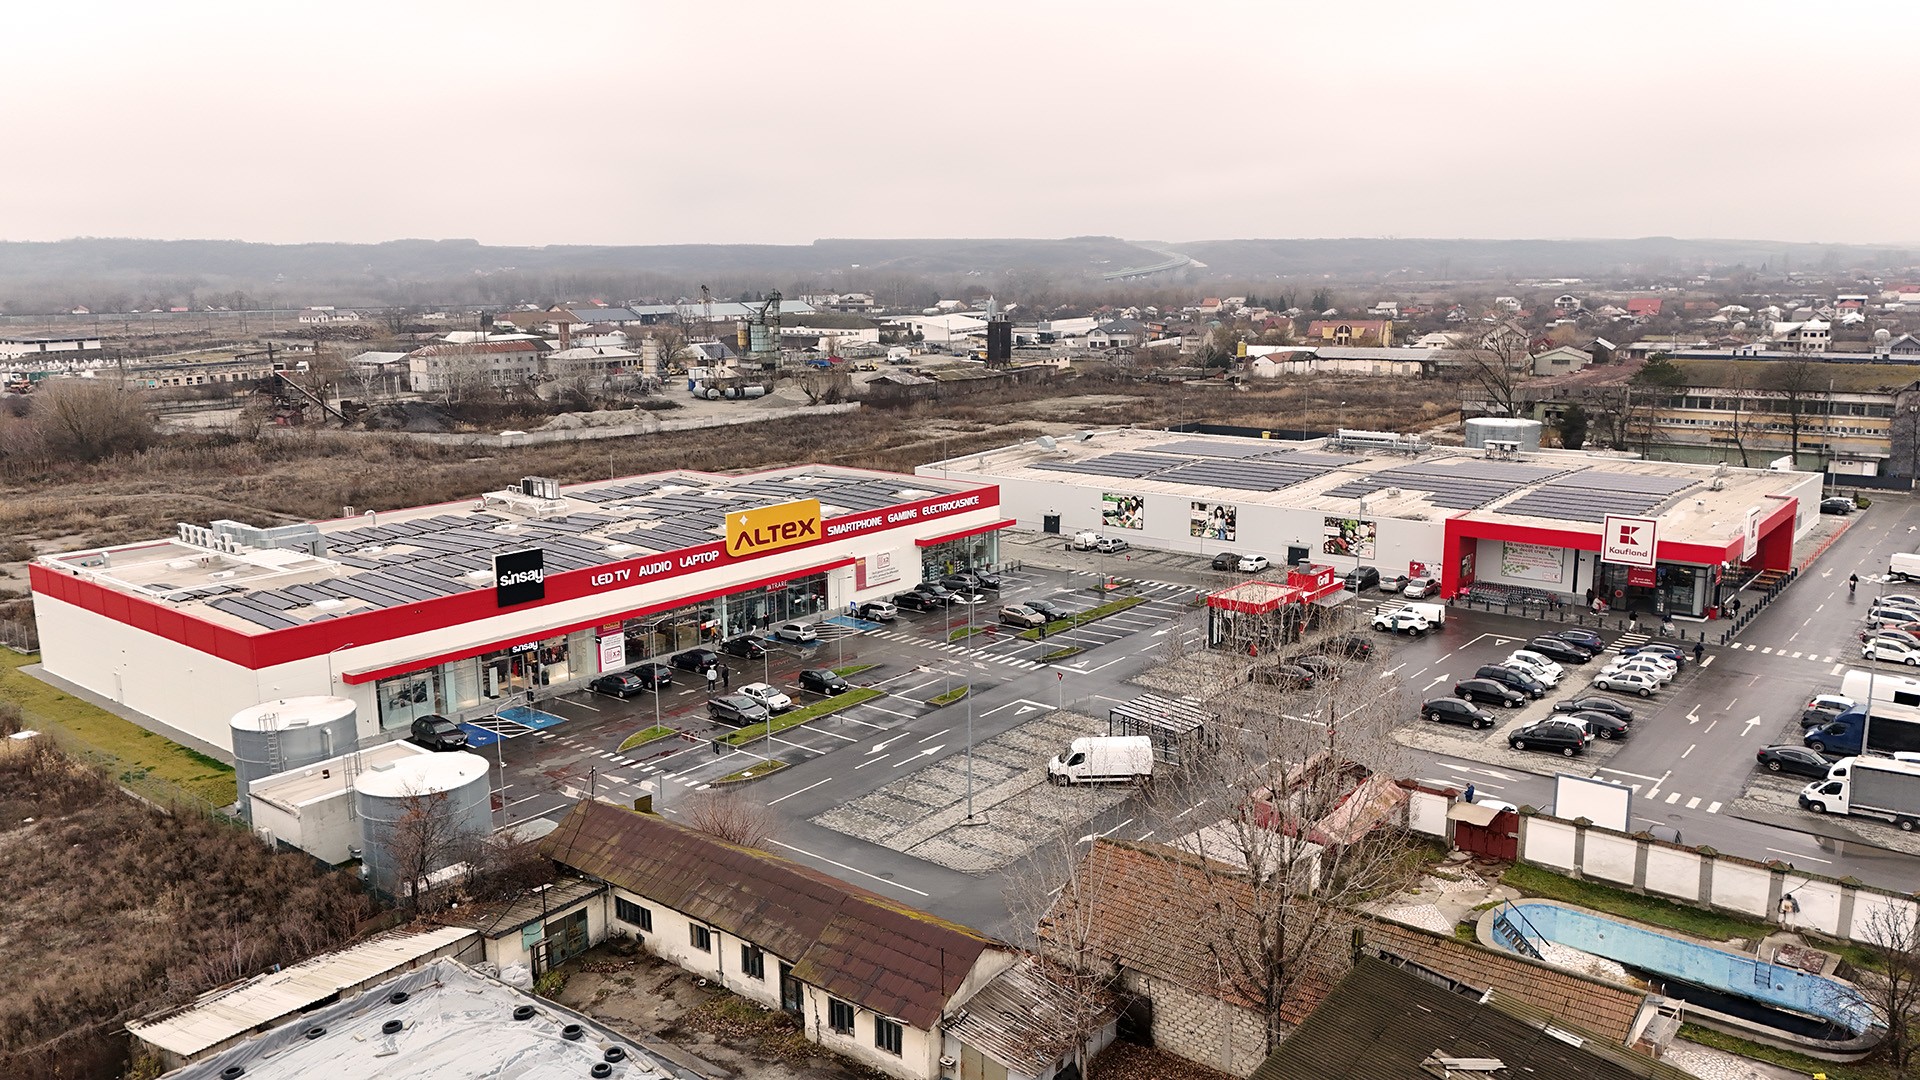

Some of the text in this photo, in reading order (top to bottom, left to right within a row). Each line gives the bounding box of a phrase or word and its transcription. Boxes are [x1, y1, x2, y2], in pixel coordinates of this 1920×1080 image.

[827, 495, 980, 536] SMARTPHONE GAMING ELECTROCASNICE
[1609, 546, 1648, 558] Kaufland
[591, 550, 720, 587] LED TV AUDIO LAPTOP
[500, 568, 544, 587] sinsay
[1317, 573, 1330, 586] Grill
[512, 640, 539, 653] sinsay
